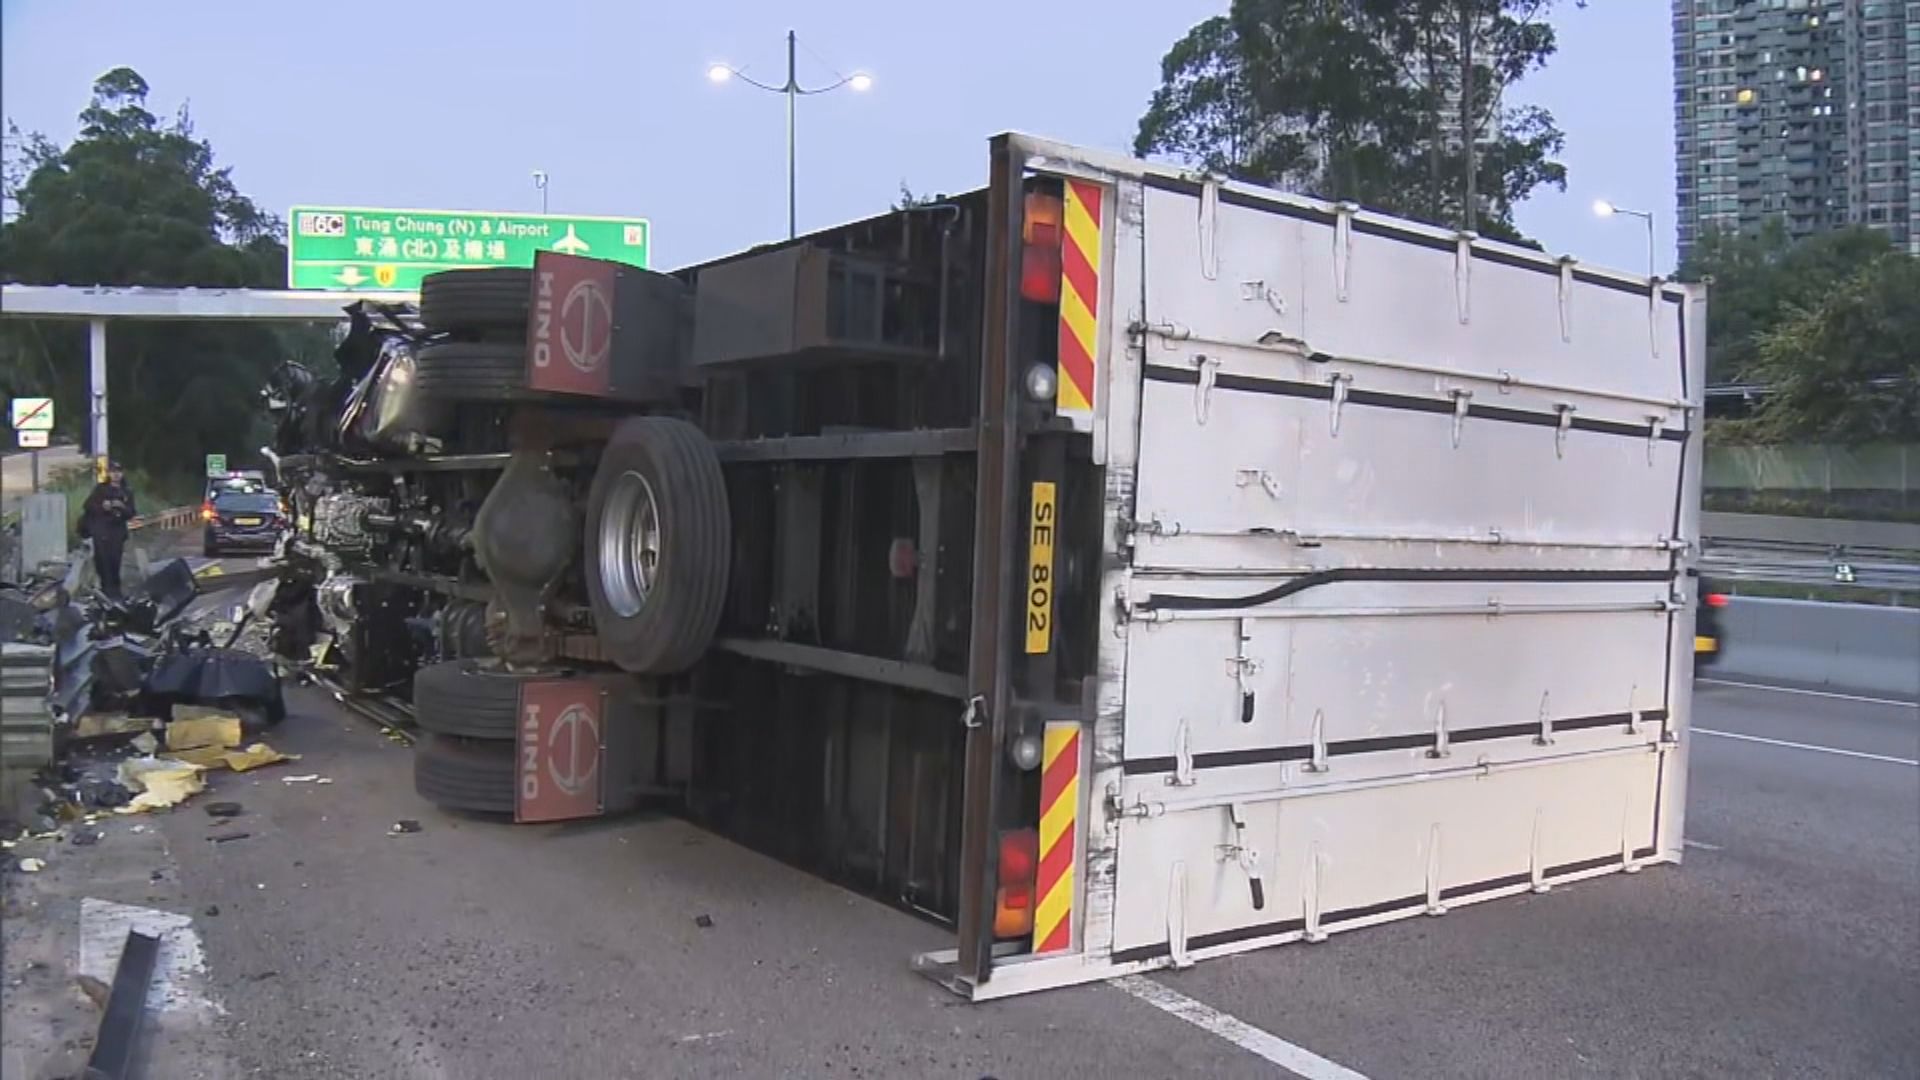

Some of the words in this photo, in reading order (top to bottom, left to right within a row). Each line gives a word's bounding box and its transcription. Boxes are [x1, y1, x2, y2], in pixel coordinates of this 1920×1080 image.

[353, 216, 391, 233] Tung
[395, 217, 445, 235] Chung
[449, 219, 476, 237] (N)
[480, 220, 492, 235] &
[497, 222, 549, 239] Airport
[535, 272, 554, 367] HINO
[1034, 502, 1052, 545] SE
[1030, 564, 1049, 631] 802
[523, 705, 540, 799] HINO
